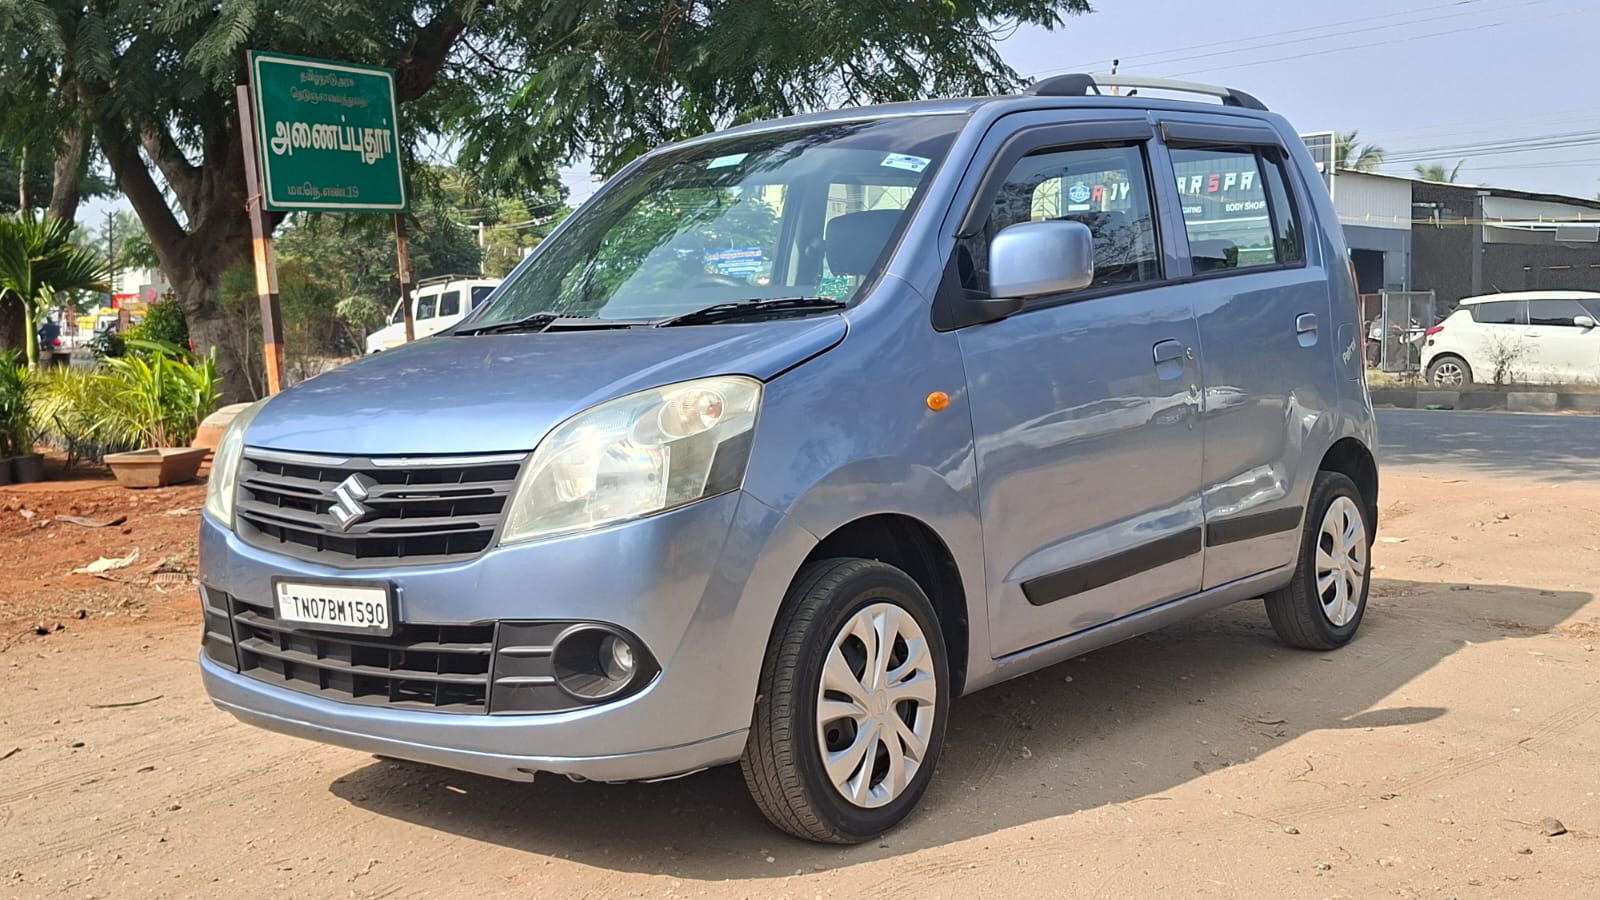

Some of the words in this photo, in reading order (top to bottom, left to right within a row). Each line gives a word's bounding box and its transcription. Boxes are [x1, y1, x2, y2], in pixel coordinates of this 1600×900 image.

[271, 114, 392, 165] அணைப்புதூர்
[1225, 202, 1244, 212] BODY
[292, 596, 385, 625] TN07BM1590
